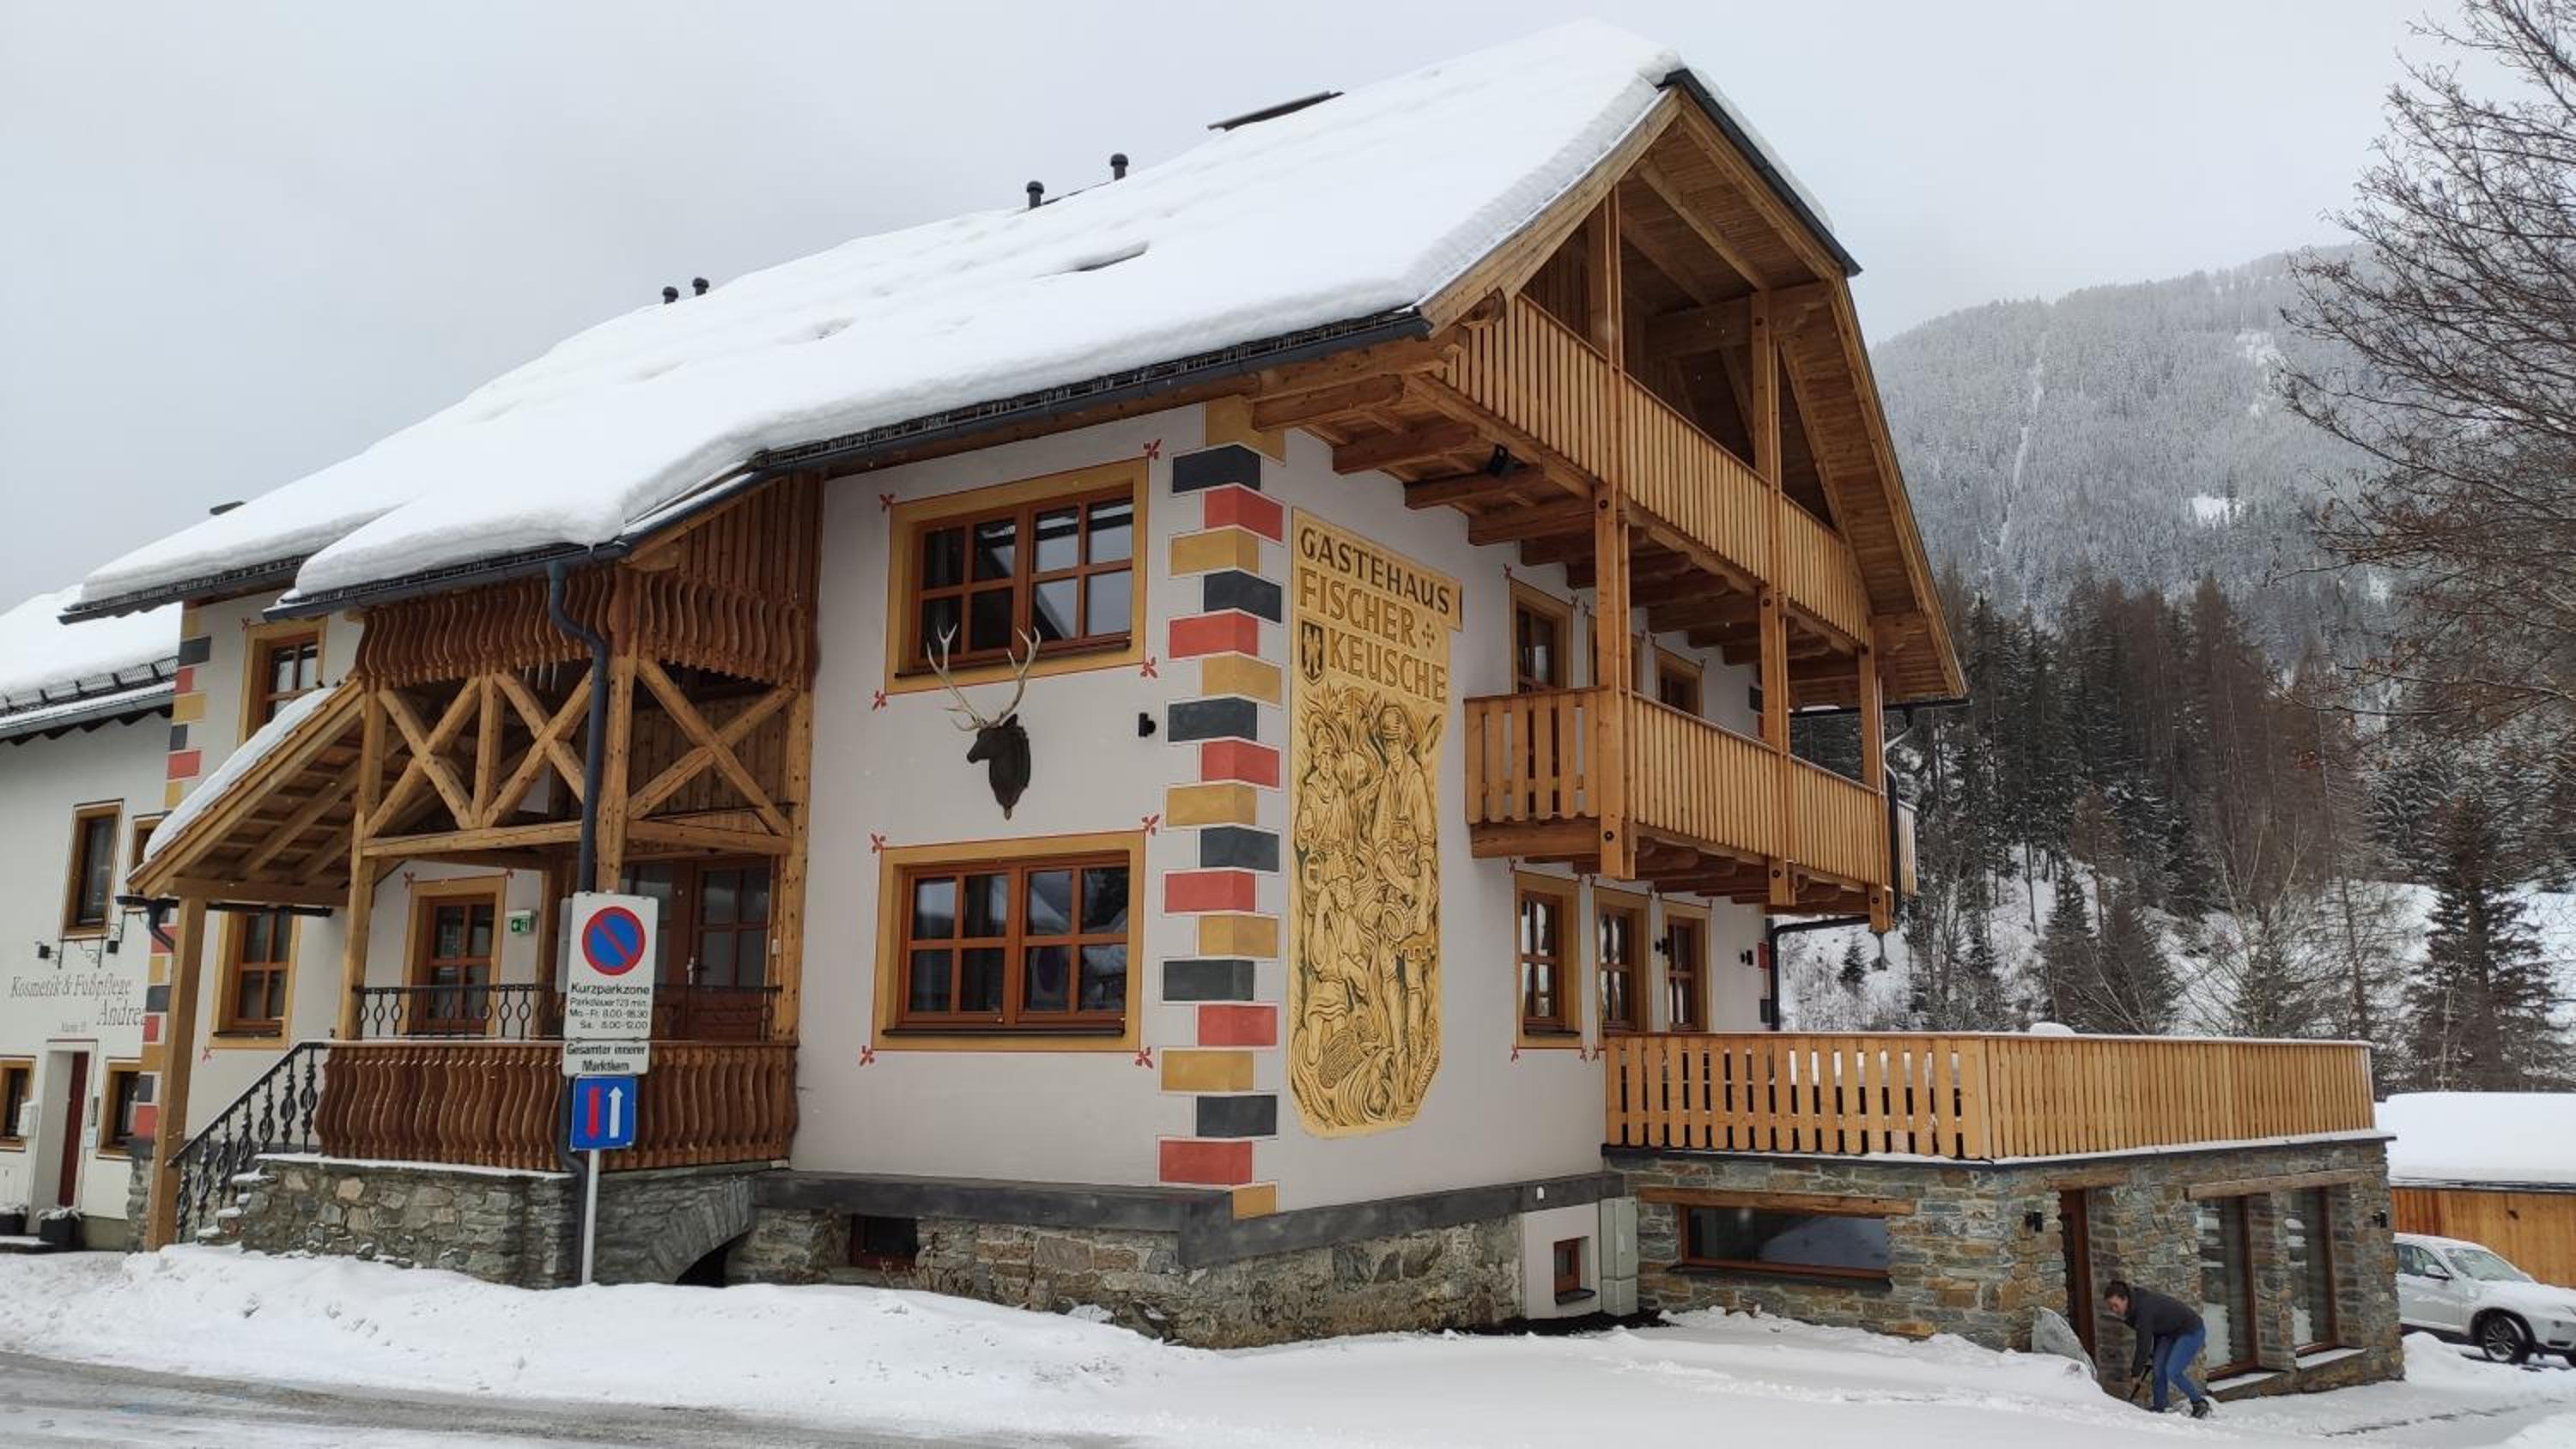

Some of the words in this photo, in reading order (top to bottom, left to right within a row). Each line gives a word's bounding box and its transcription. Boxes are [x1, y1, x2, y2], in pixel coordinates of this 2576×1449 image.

[1300, 527, 1450, 615] GÄSTEHAUS
[1299, 567, 1417, 649] FISCHER
[1328, 627, 1446, 702] KEUSCHE
[10, 975, 59, 997] Kosmetik
[61, 973, 72, 995] &
[73, 972, 131, 1002] Fußpflege
[571, 982, 650, 996] Kurzparkzone
[567, 1043, 611, 1055] Gesamter
[614, 1046, 647, 1055] innerer
